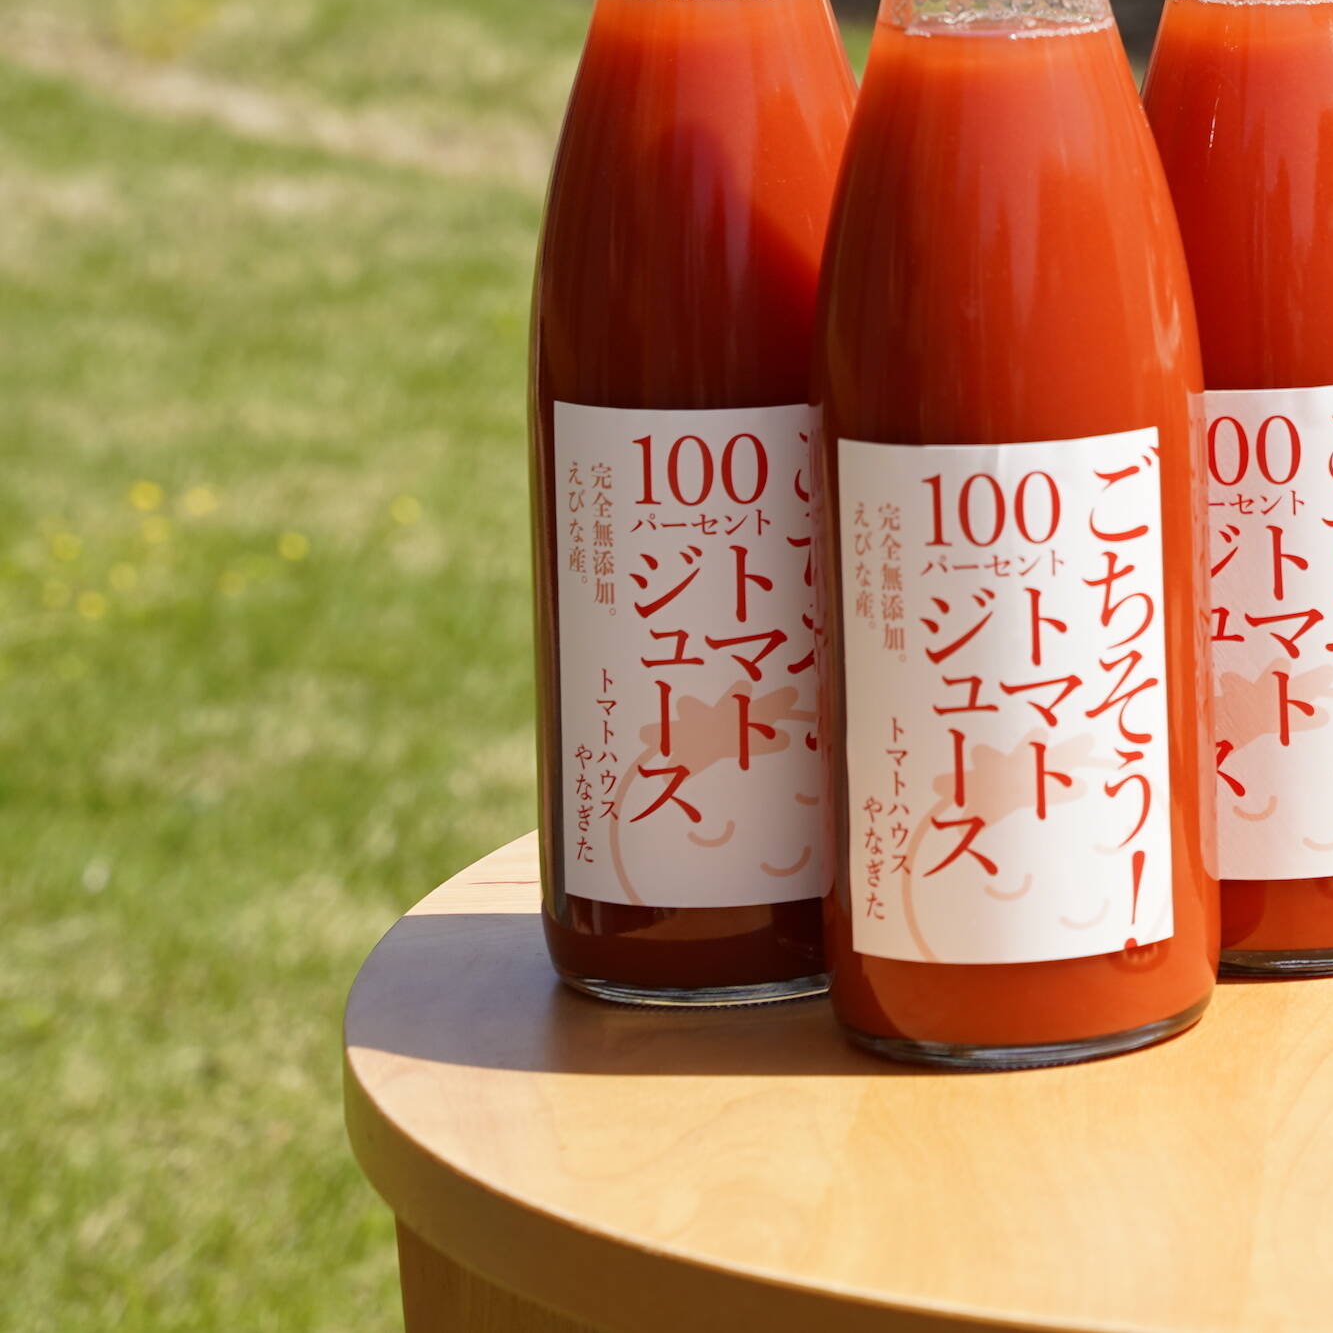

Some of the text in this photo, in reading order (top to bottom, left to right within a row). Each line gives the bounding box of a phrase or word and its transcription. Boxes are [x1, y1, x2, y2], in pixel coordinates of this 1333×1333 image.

[632, 433, 768, 507] 100
[922, 471, 1060, 547] 100
[1207, 415, 1301, 486] 00
[1207, 489, 1305, 516] ーセント
[567, 461, 588, 585] えびな産。
[591, 462, 617, 617] 完全無添加。
[630, 509, 771, 537] パーセント
[853, 502, 876, 630] えびな産。
[878, 502, 907, 664] 完全無添加。
[920, 549, 1065, 578] パーセント
[629, 545, 704, 824] ジュース
[705, 544, 788, 771] トマト
[1000, 587, 1083, 820] トマト
[1081, 446, 1160, 949] ごちそう！
[1244, 525, 1324, 747] トマト
[596, 668, 619, 822] トマトハウス
[886, 717, 912, 875] トマトハウス
[919, 587, 999, 878] ジュース
[574, 744, 595, 864] やなぎた
[863, 796, 886, 921] やなぎた
